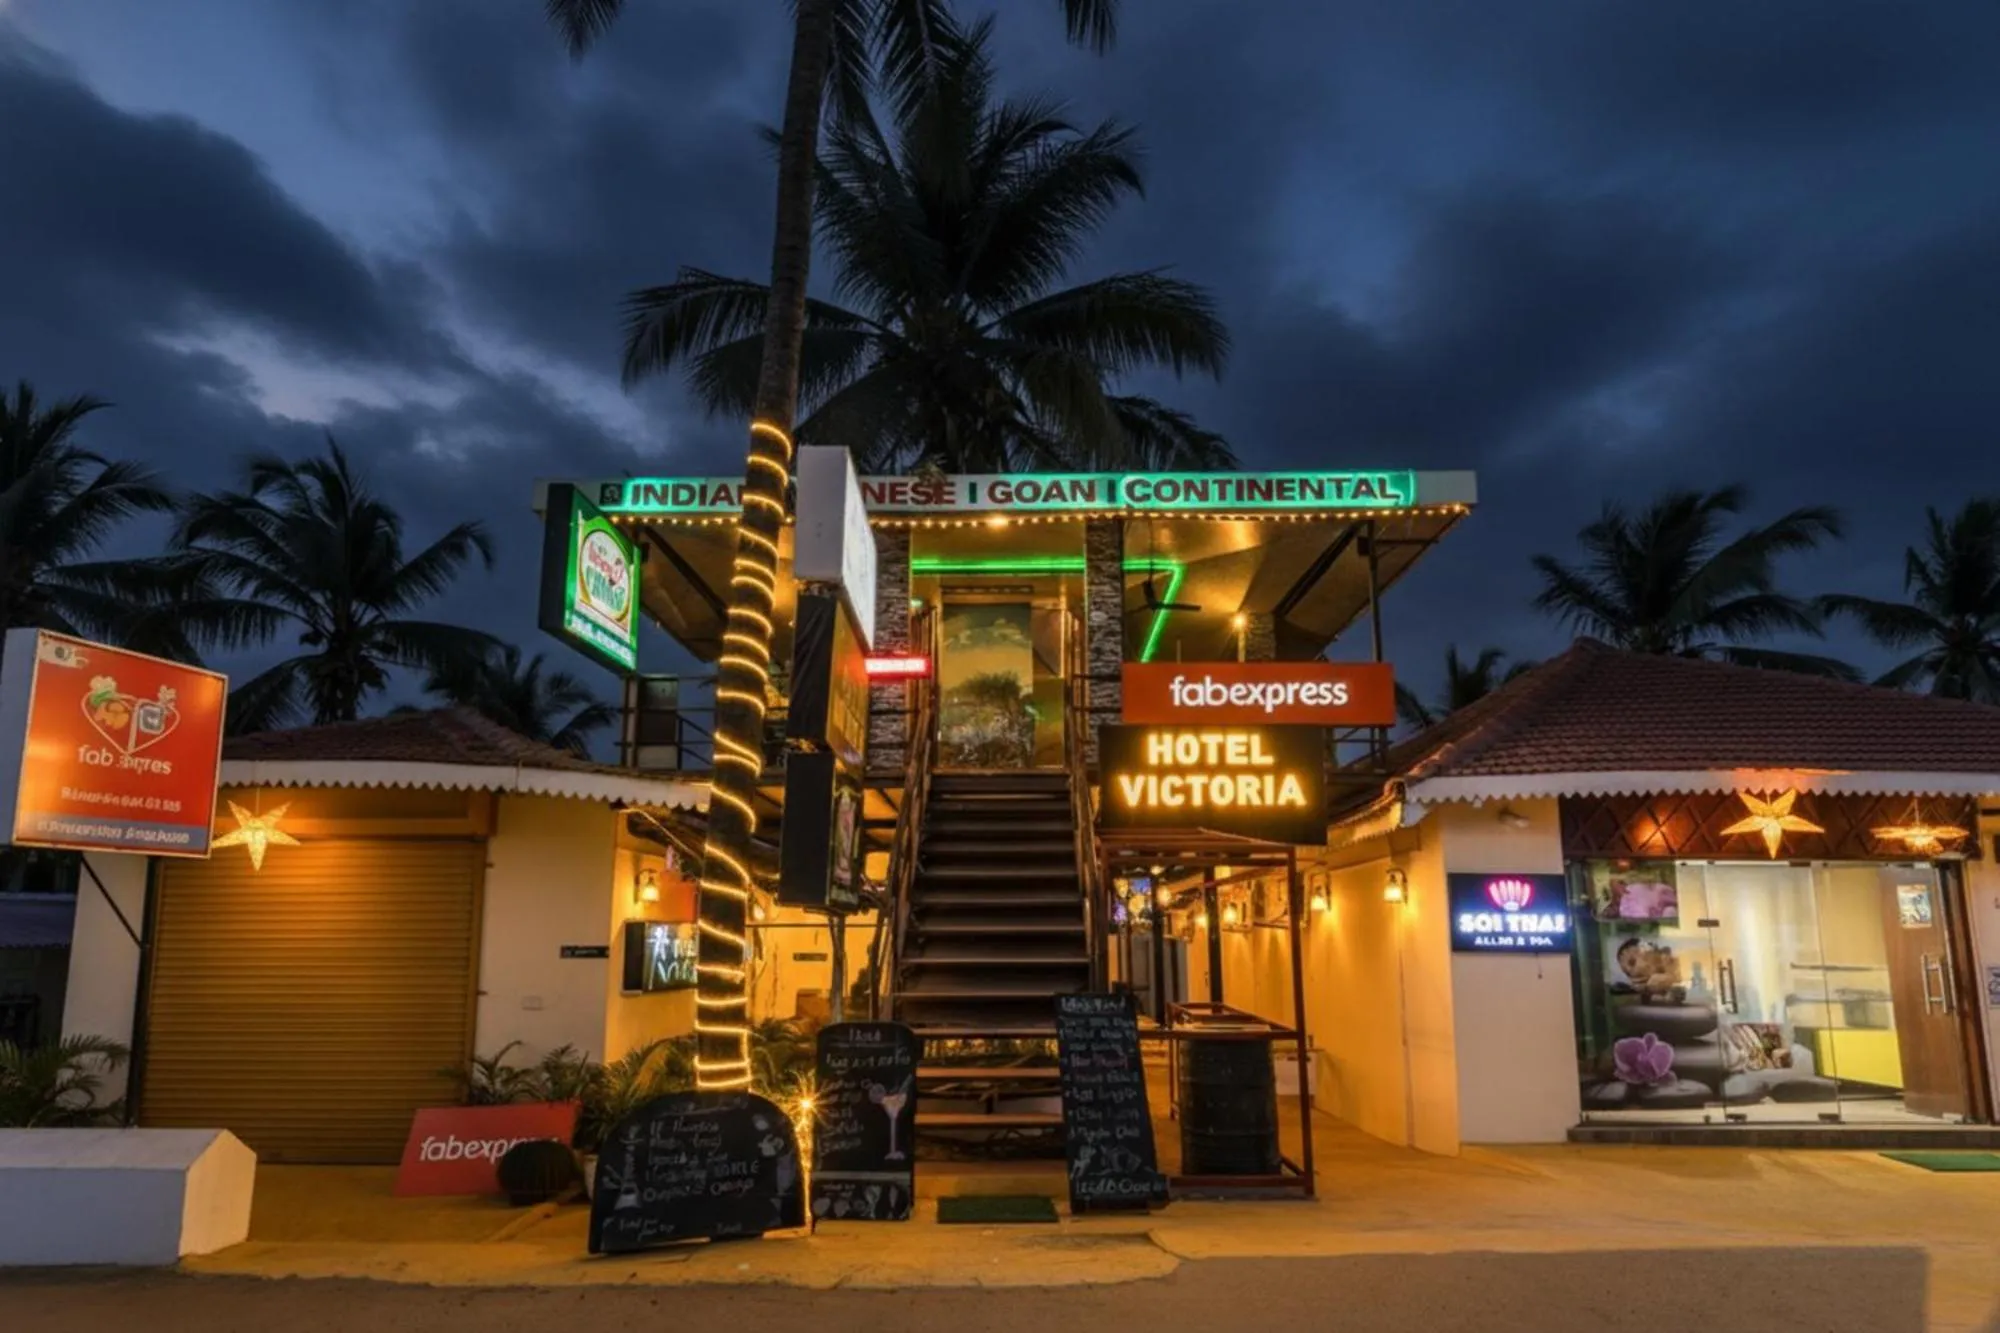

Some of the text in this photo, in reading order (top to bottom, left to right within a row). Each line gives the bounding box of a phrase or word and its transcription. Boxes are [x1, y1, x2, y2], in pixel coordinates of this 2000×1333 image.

[862, 481, 956, 505] NESE
[988, 480, 1096, 504] GOAN
[1125, 477, 1400, 503] CONTINENTAL
[1169, 675, 1348, 712] fabexpress
[1147, 733, 1274, 765] HOTEL
[1119, 773, 1307, 807] VICTORIA
[420, 1135, 559, 1164] fabexp
